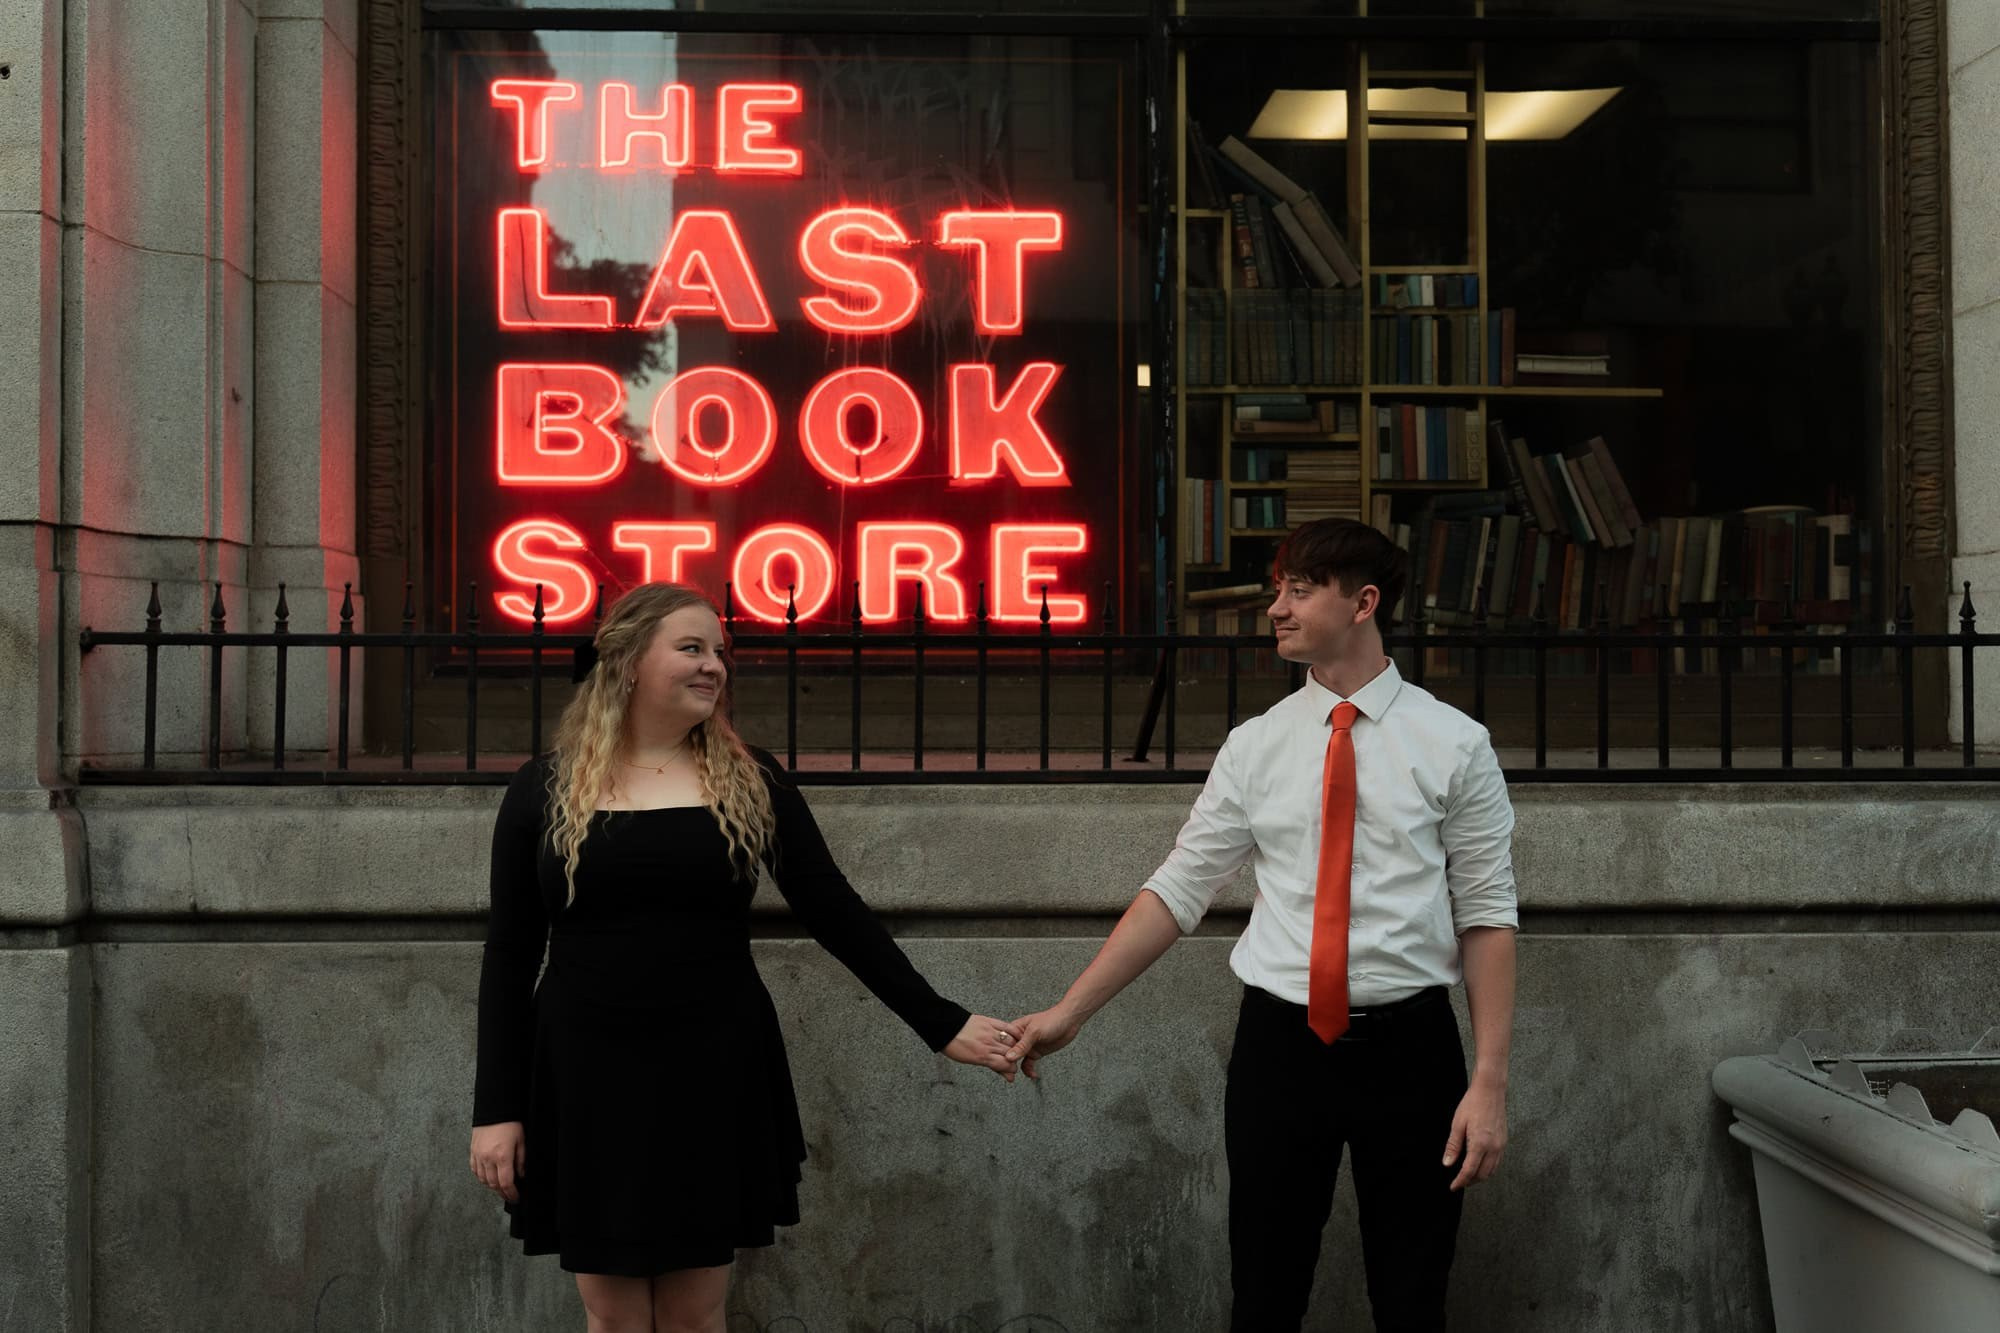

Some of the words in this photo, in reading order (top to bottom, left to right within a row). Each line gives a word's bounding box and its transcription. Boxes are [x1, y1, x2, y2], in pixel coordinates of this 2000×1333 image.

[491, 79, 801, 175] THE
[495, 207, 1063, 335] LAST
[495, 363, 1070, 487] BOOK
[492, 519, 1088, 624] STORE
